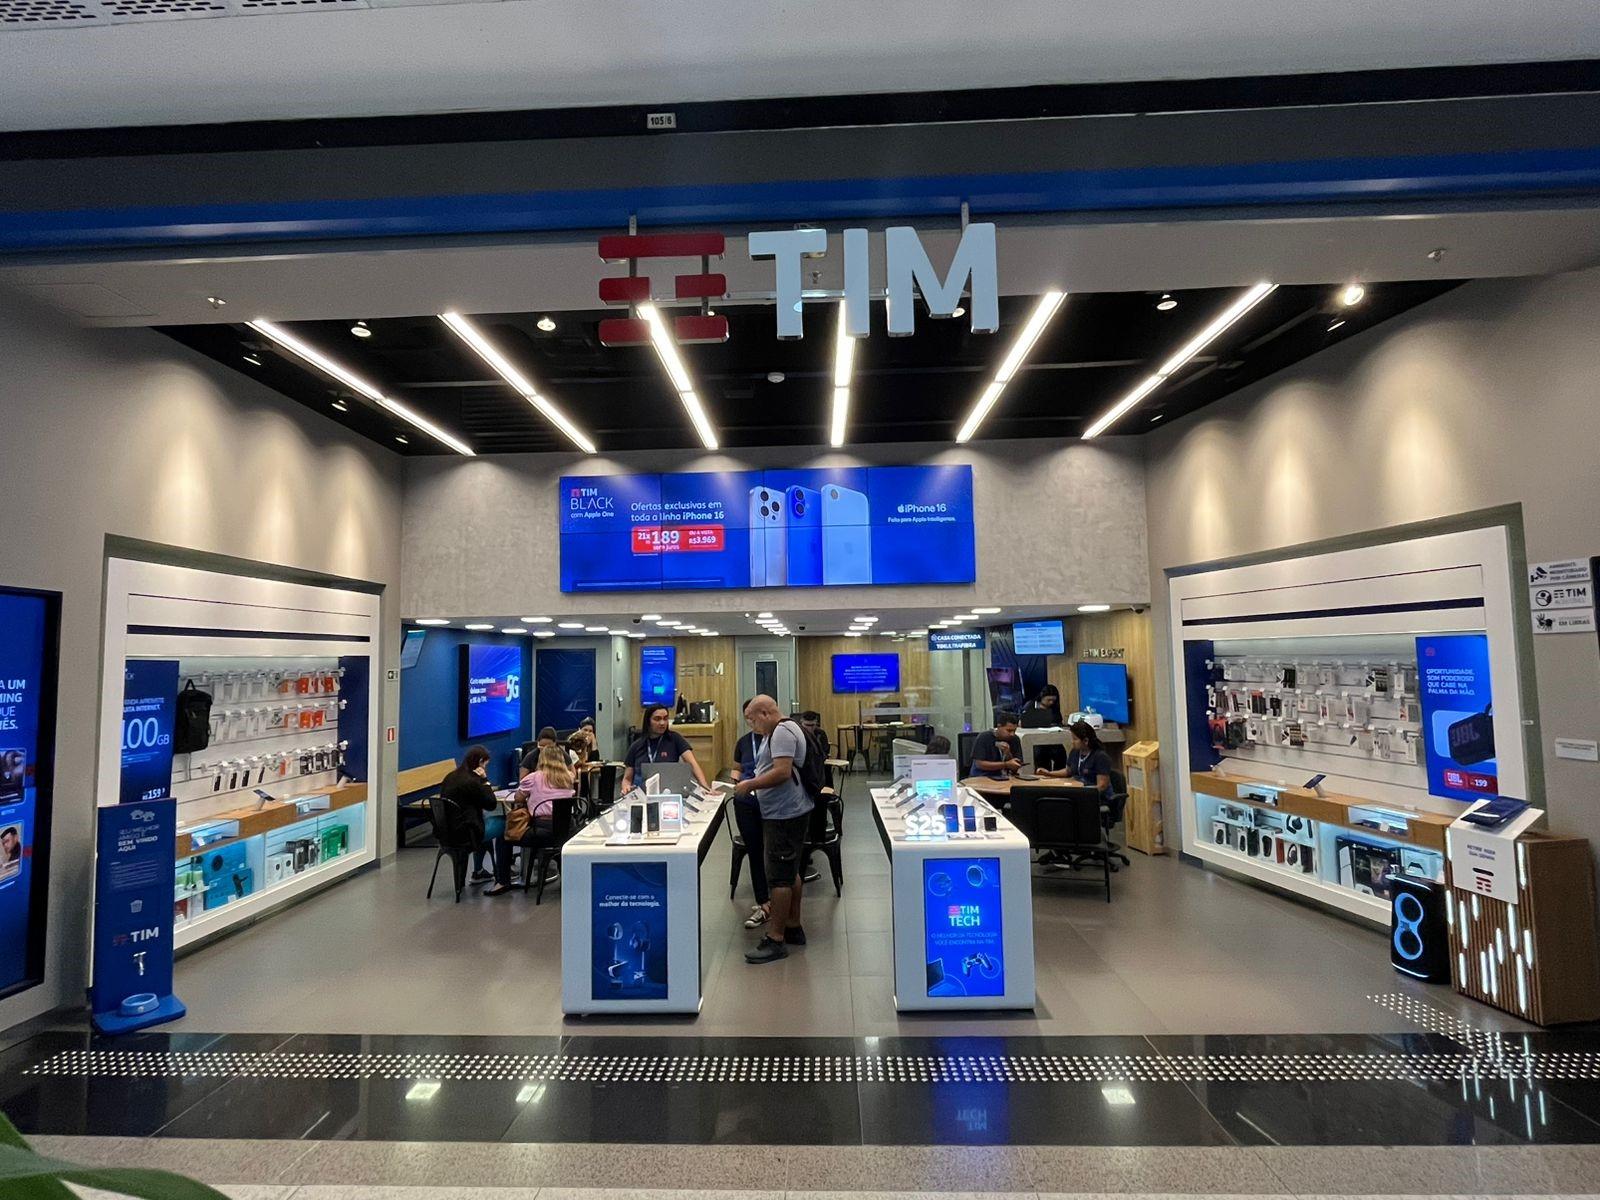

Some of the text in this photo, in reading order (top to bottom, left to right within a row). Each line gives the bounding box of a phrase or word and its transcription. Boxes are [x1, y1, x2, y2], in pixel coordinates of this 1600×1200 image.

[748, 222, 1000, 340] TIM
[580, 487, 598, 497] TIM
[570, 496, 614, 510] BLACK
[630, 500, 722, 511] Ofertas exclusivas em
[904, 503, 947, 512] iPhone 16
[584, 511, 601, 519] Apple
[630, 513, 651, 521] toda
[659, 512, 680, 521] linha
[682, 511, 713, 520] iPhone
[713, 511, 725, 519] 16
[637, 532, 651, 540] 21x
[651, 530, 680, 544] 189
[1565, 587, 1587, 598] TIM
[696, 662, 724, 677] TIM
[8, 679, 26, 690] UM
[505, 674, 520, 703] 5G
[0, 717, 19, 730] ÉS.
[1451, 722, 1480, 747] JBL
[905, 814, 946, 836] S25
[118, 835, 159, 847] BEM VINDO
[118, 844, 137, 852] AQUI
[960, 905, 980, 915] TIM
[948, 915, 981, 927] TECH
[130, 926, 160, 943] TIM
